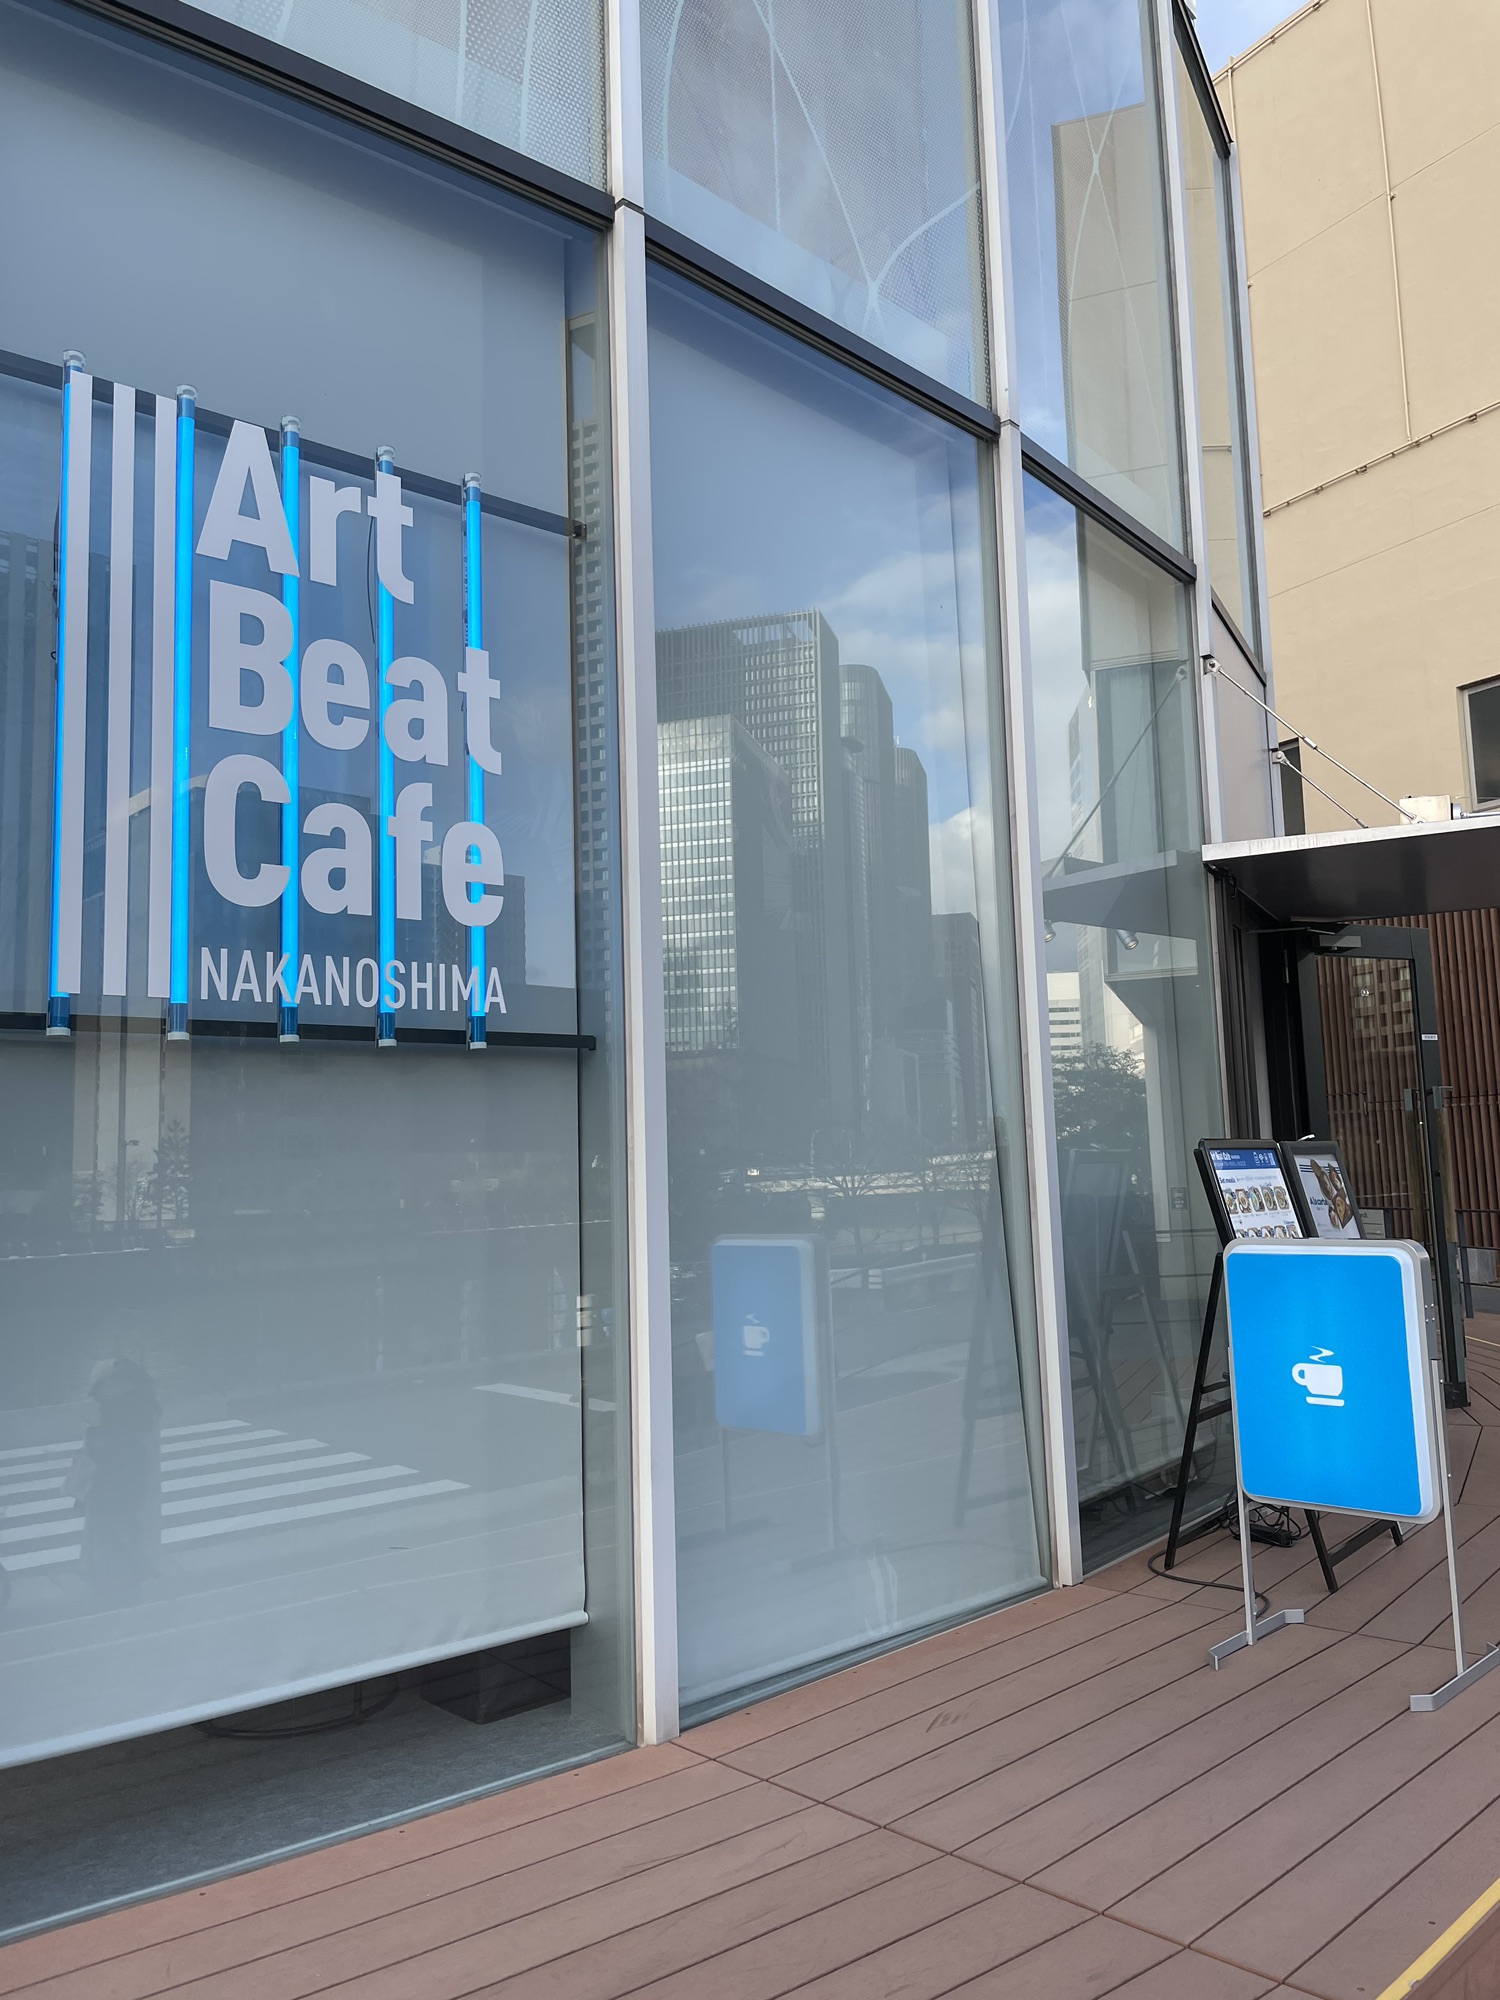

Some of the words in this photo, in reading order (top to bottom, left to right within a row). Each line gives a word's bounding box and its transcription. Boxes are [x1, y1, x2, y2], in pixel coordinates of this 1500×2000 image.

[196, 420, 415, 605] Art
[208, 579, 502, 775] Beat
[203, 754, 505, 927] Cafe
[199, 946, 507, 1014] NAKANOSHIMA
